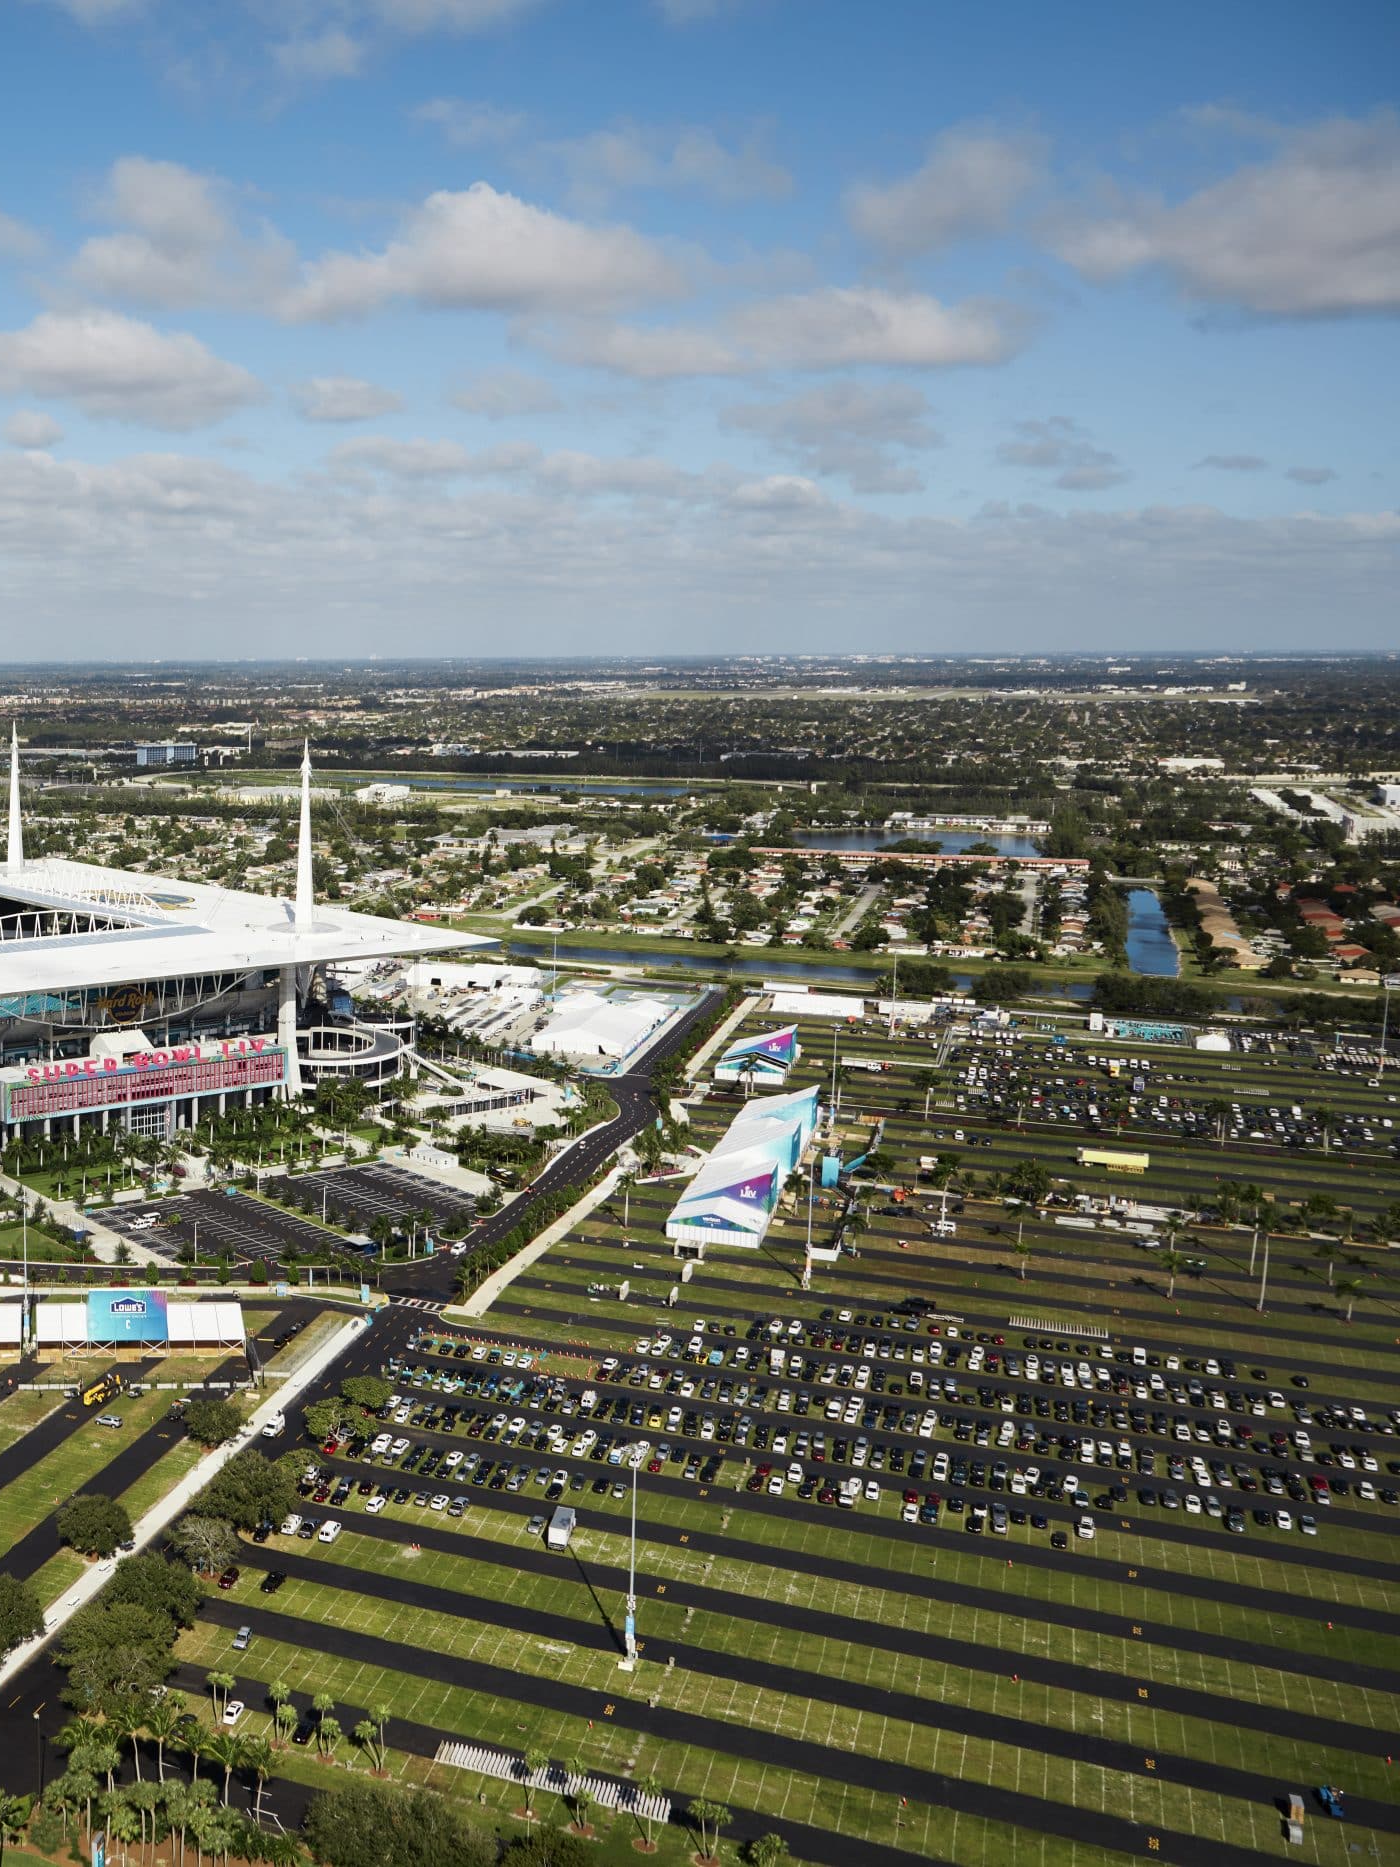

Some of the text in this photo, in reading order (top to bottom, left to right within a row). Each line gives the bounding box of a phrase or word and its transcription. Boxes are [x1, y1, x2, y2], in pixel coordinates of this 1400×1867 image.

[96, 990, 155, 1009] Hard Rock
[27, 1038, 265, 1086] SUPER BOWL LIV
[740, 1185, 757, 1199] LIV
[114, 1302, 143, 1311] LOWE'S
